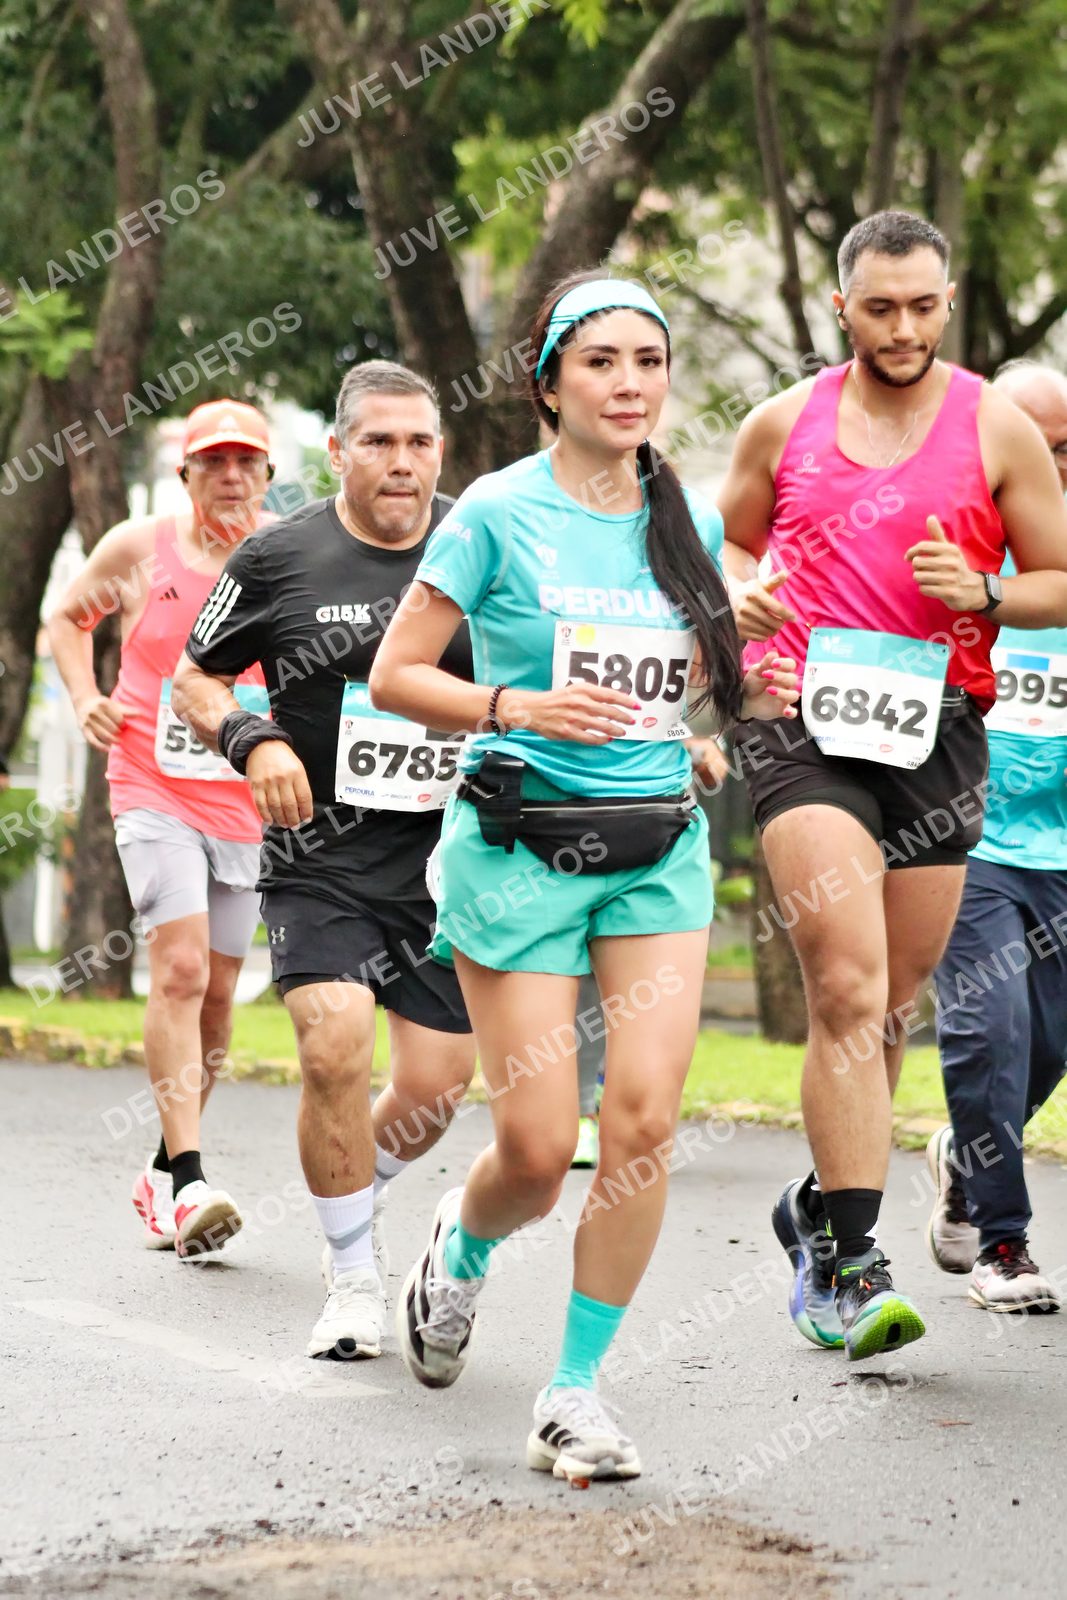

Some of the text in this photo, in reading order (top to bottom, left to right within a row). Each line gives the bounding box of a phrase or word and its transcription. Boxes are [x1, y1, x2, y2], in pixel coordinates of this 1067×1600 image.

[315, 603, 371, 624] G15K
[565, 651, 688, 703] 5805
[995, 669, 1067, 709] 995
[811, 686, 928, 738] 6842
[348, 740, 461, 782] 6785
[344, 786, 375, 797] PERDURA
